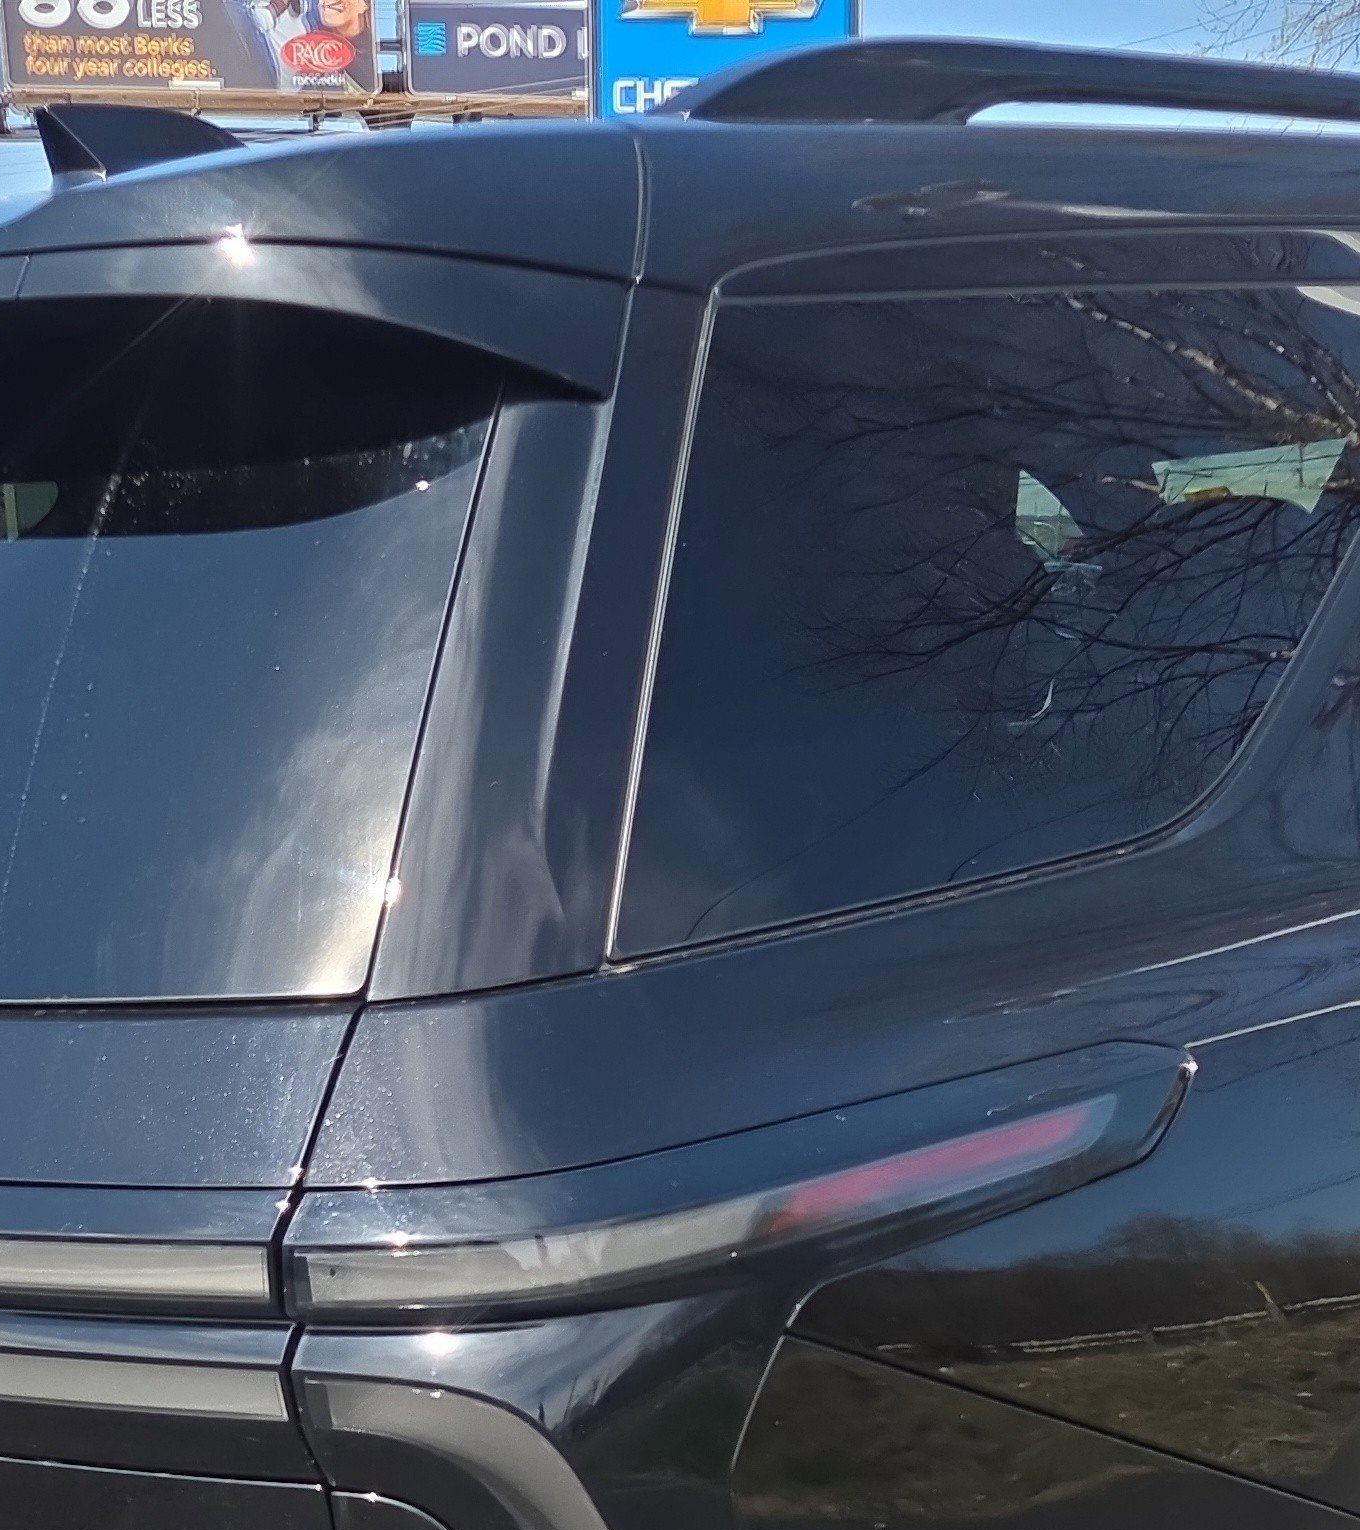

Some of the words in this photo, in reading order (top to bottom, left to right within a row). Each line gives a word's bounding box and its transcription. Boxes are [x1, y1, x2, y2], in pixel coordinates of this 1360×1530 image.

[137, 0, 202, 29] LESS
[23, 31, 74, 54] than
[76, 33, 133, 55] most
[134, 33, 195, 56] Berks
[457, 23, 566, 58] POND
[25, 55, 71, 75] four
[72, 57, 121, 80] year
[122, 55, 217, 81] colleges.
[291, 39, 343, 72] RACC
